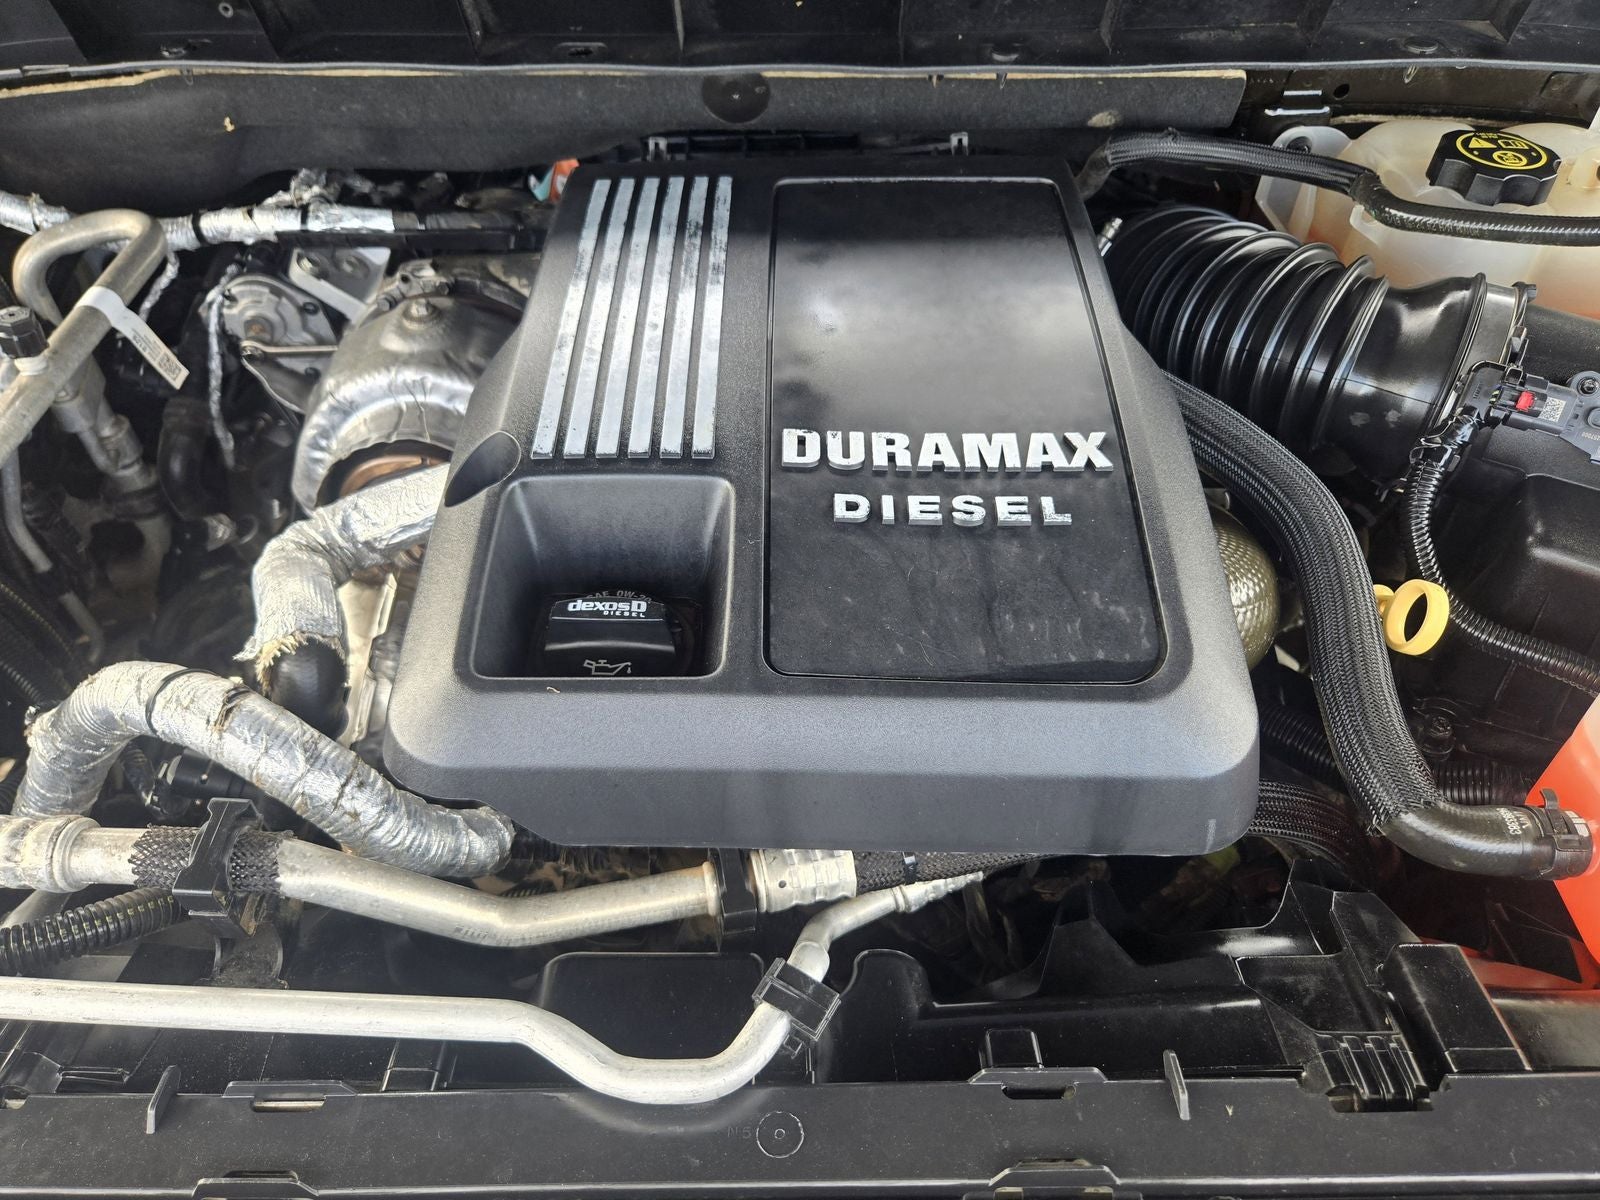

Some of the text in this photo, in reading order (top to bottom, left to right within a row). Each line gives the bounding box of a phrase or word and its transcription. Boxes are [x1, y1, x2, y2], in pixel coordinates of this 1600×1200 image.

[781, 428, 1113, 472] DURAMAX
[833, 493, 1072, 526] DIESEL
[567, 600, 647, 613] dexosD
